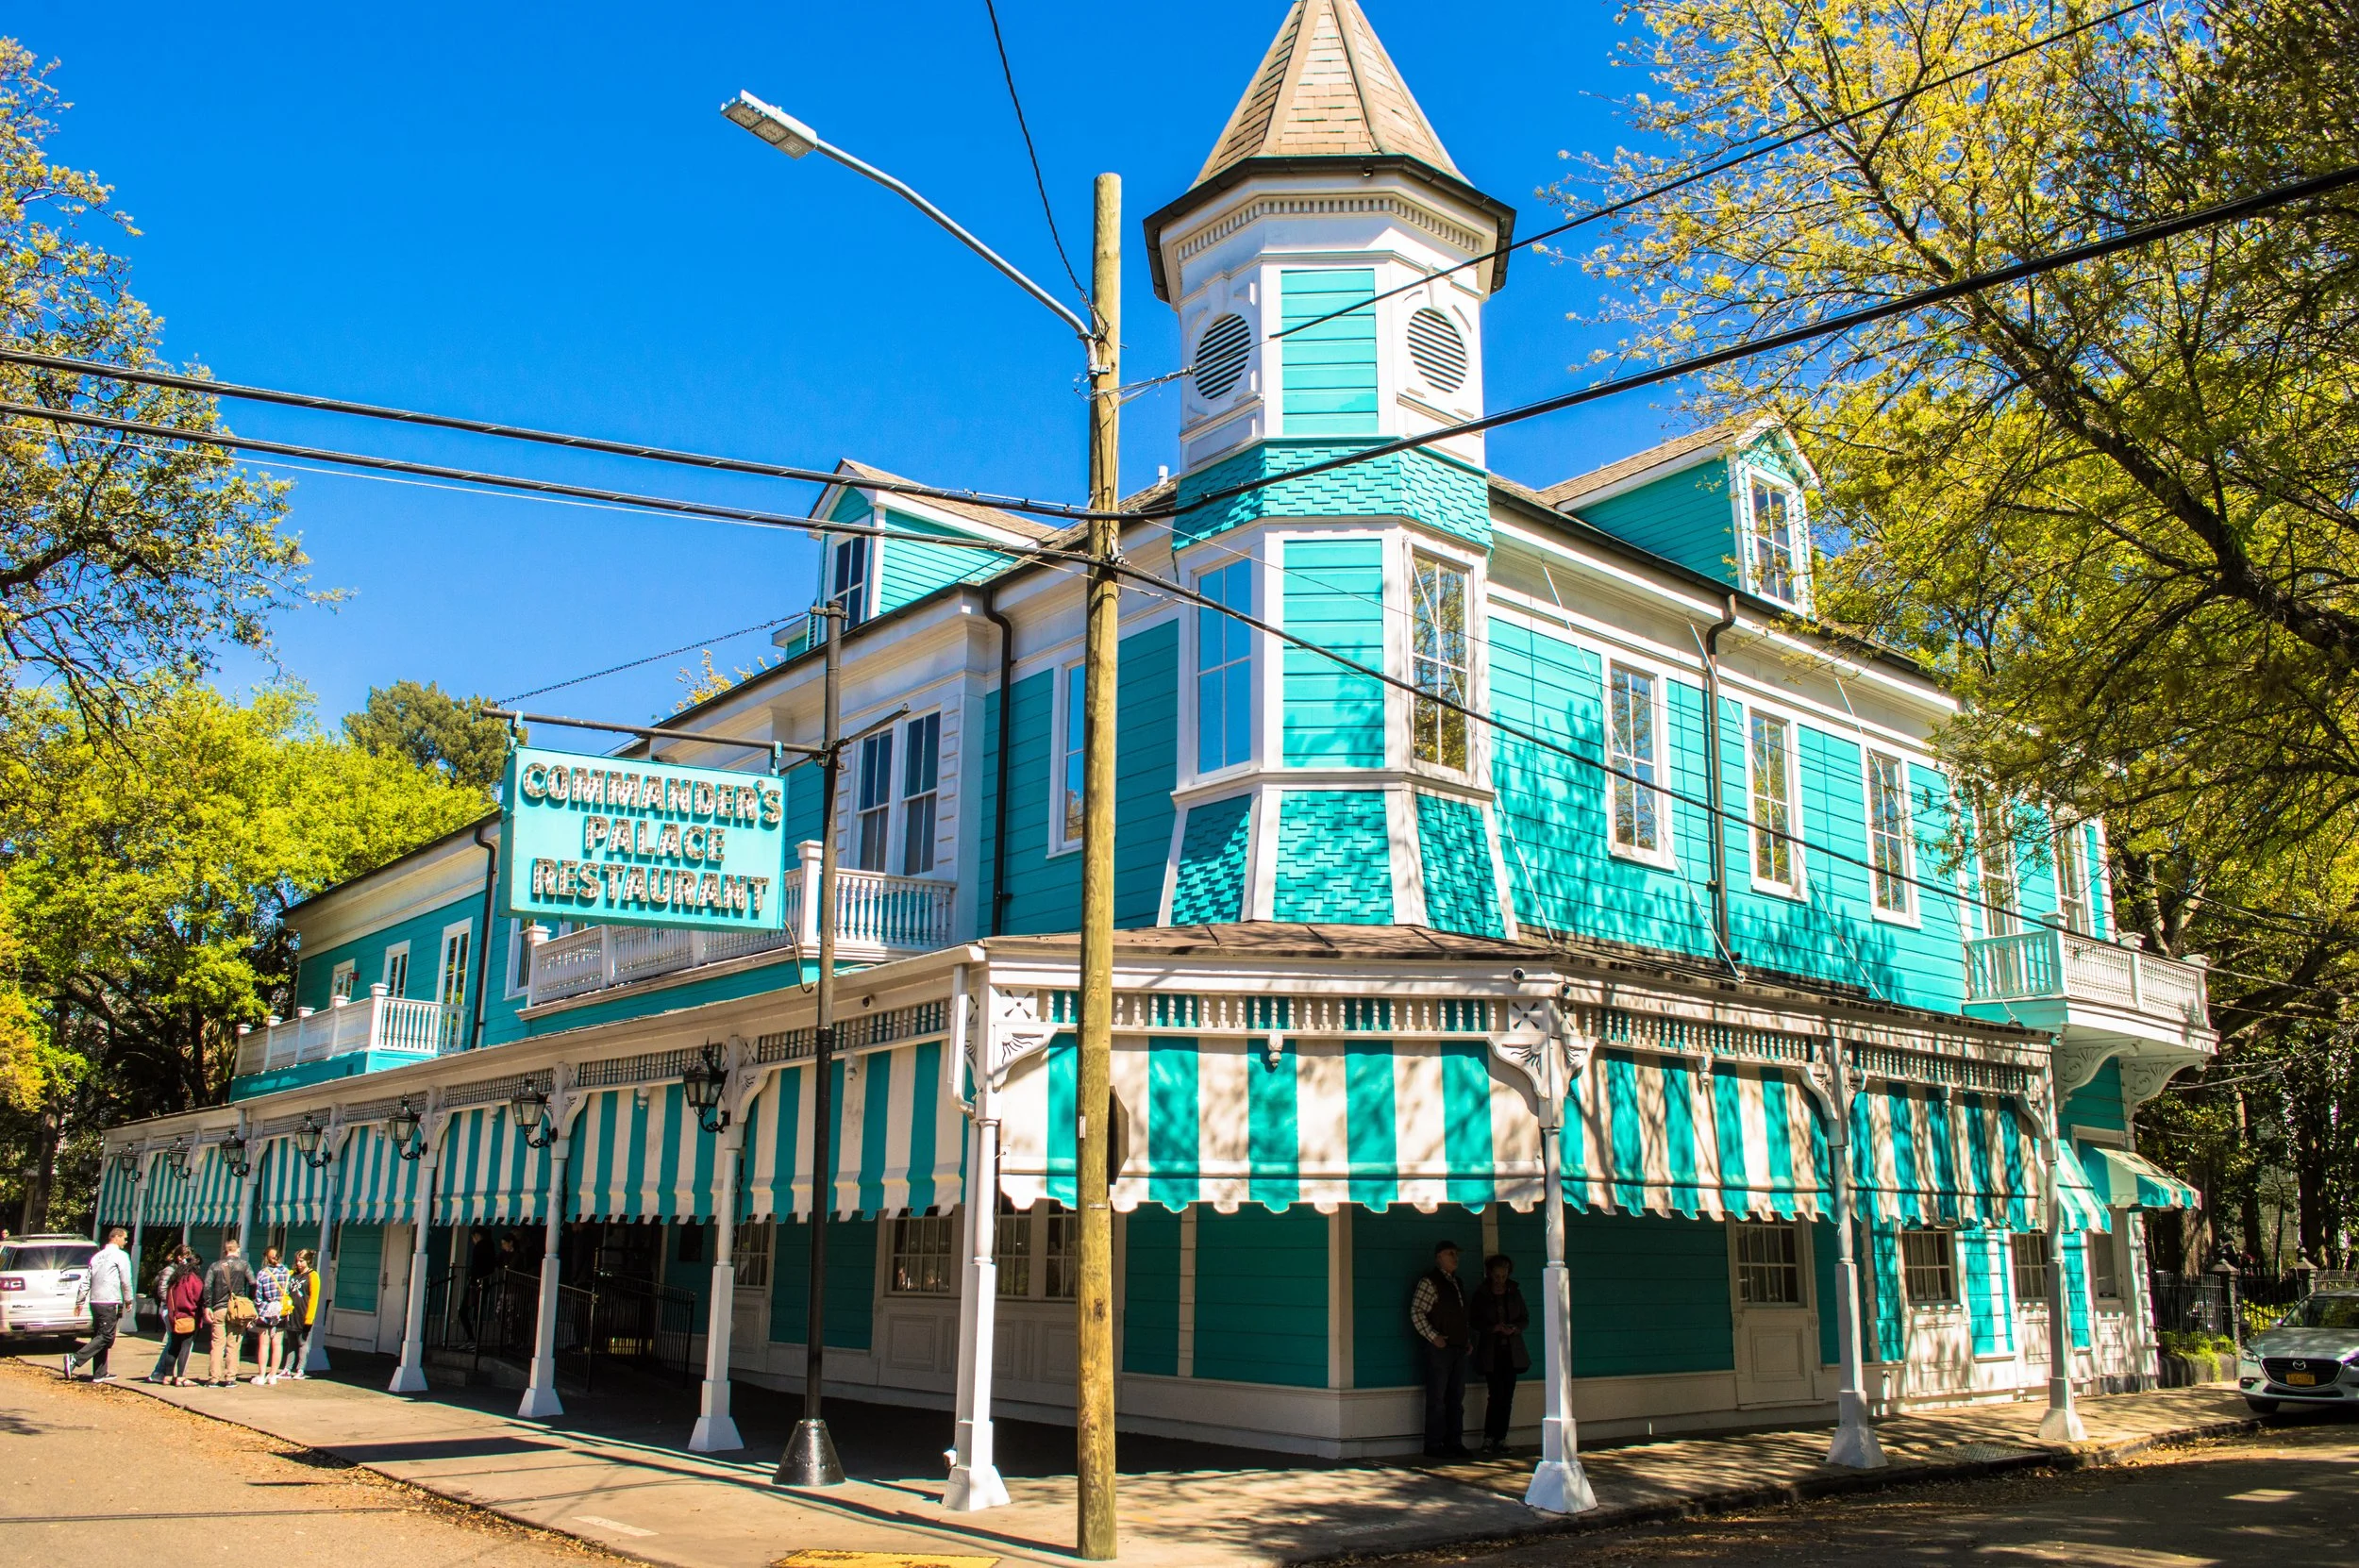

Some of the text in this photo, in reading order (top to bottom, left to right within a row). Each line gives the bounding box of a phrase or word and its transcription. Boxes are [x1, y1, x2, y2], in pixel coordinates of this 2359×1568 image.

[523, 762, 783, 823] COMMANDER'S
[584, 815, 726, 861] PALACE
[532, 858, 770, 911] RESTAURANT
